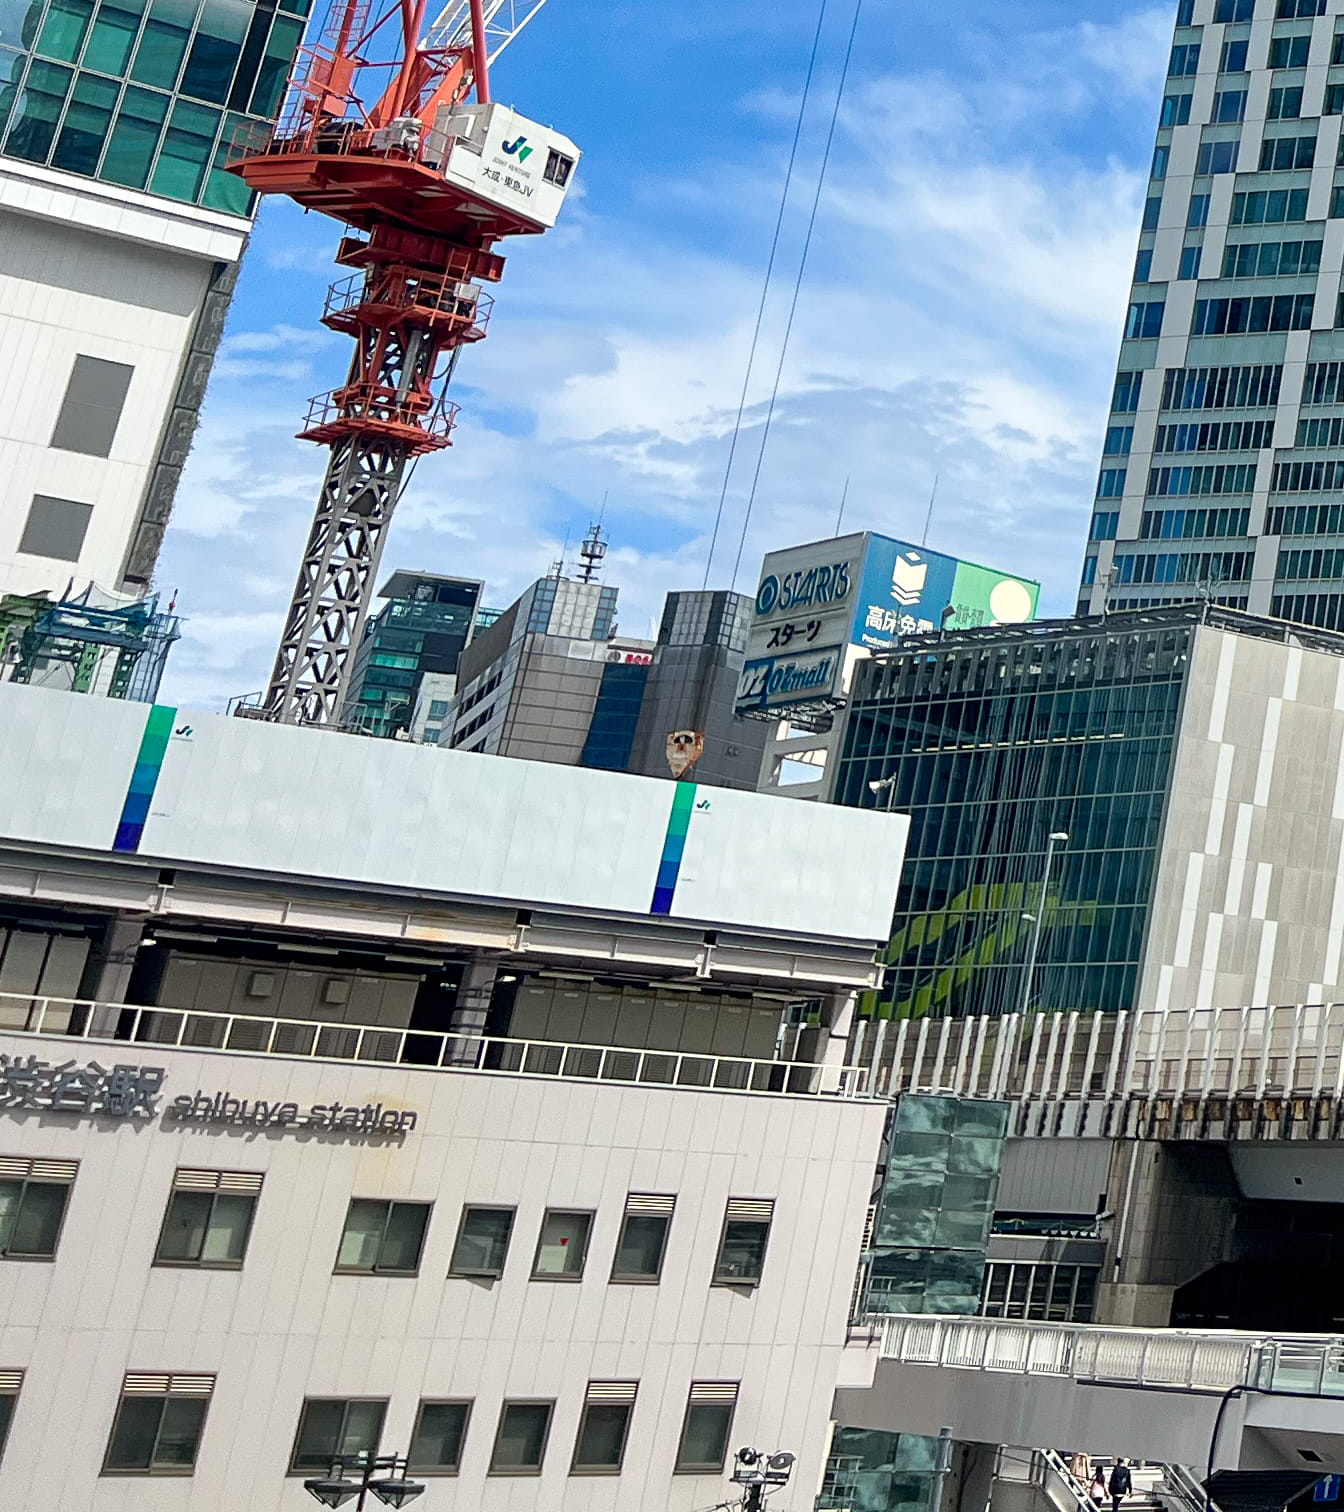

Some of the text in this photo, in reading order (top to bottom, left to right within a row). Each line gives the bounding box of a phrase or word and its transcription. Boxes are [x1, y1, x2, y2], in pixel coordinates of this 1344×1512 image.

[767, 620, 822, 649] スターツ
[309, 1101, 417, 1134] station
